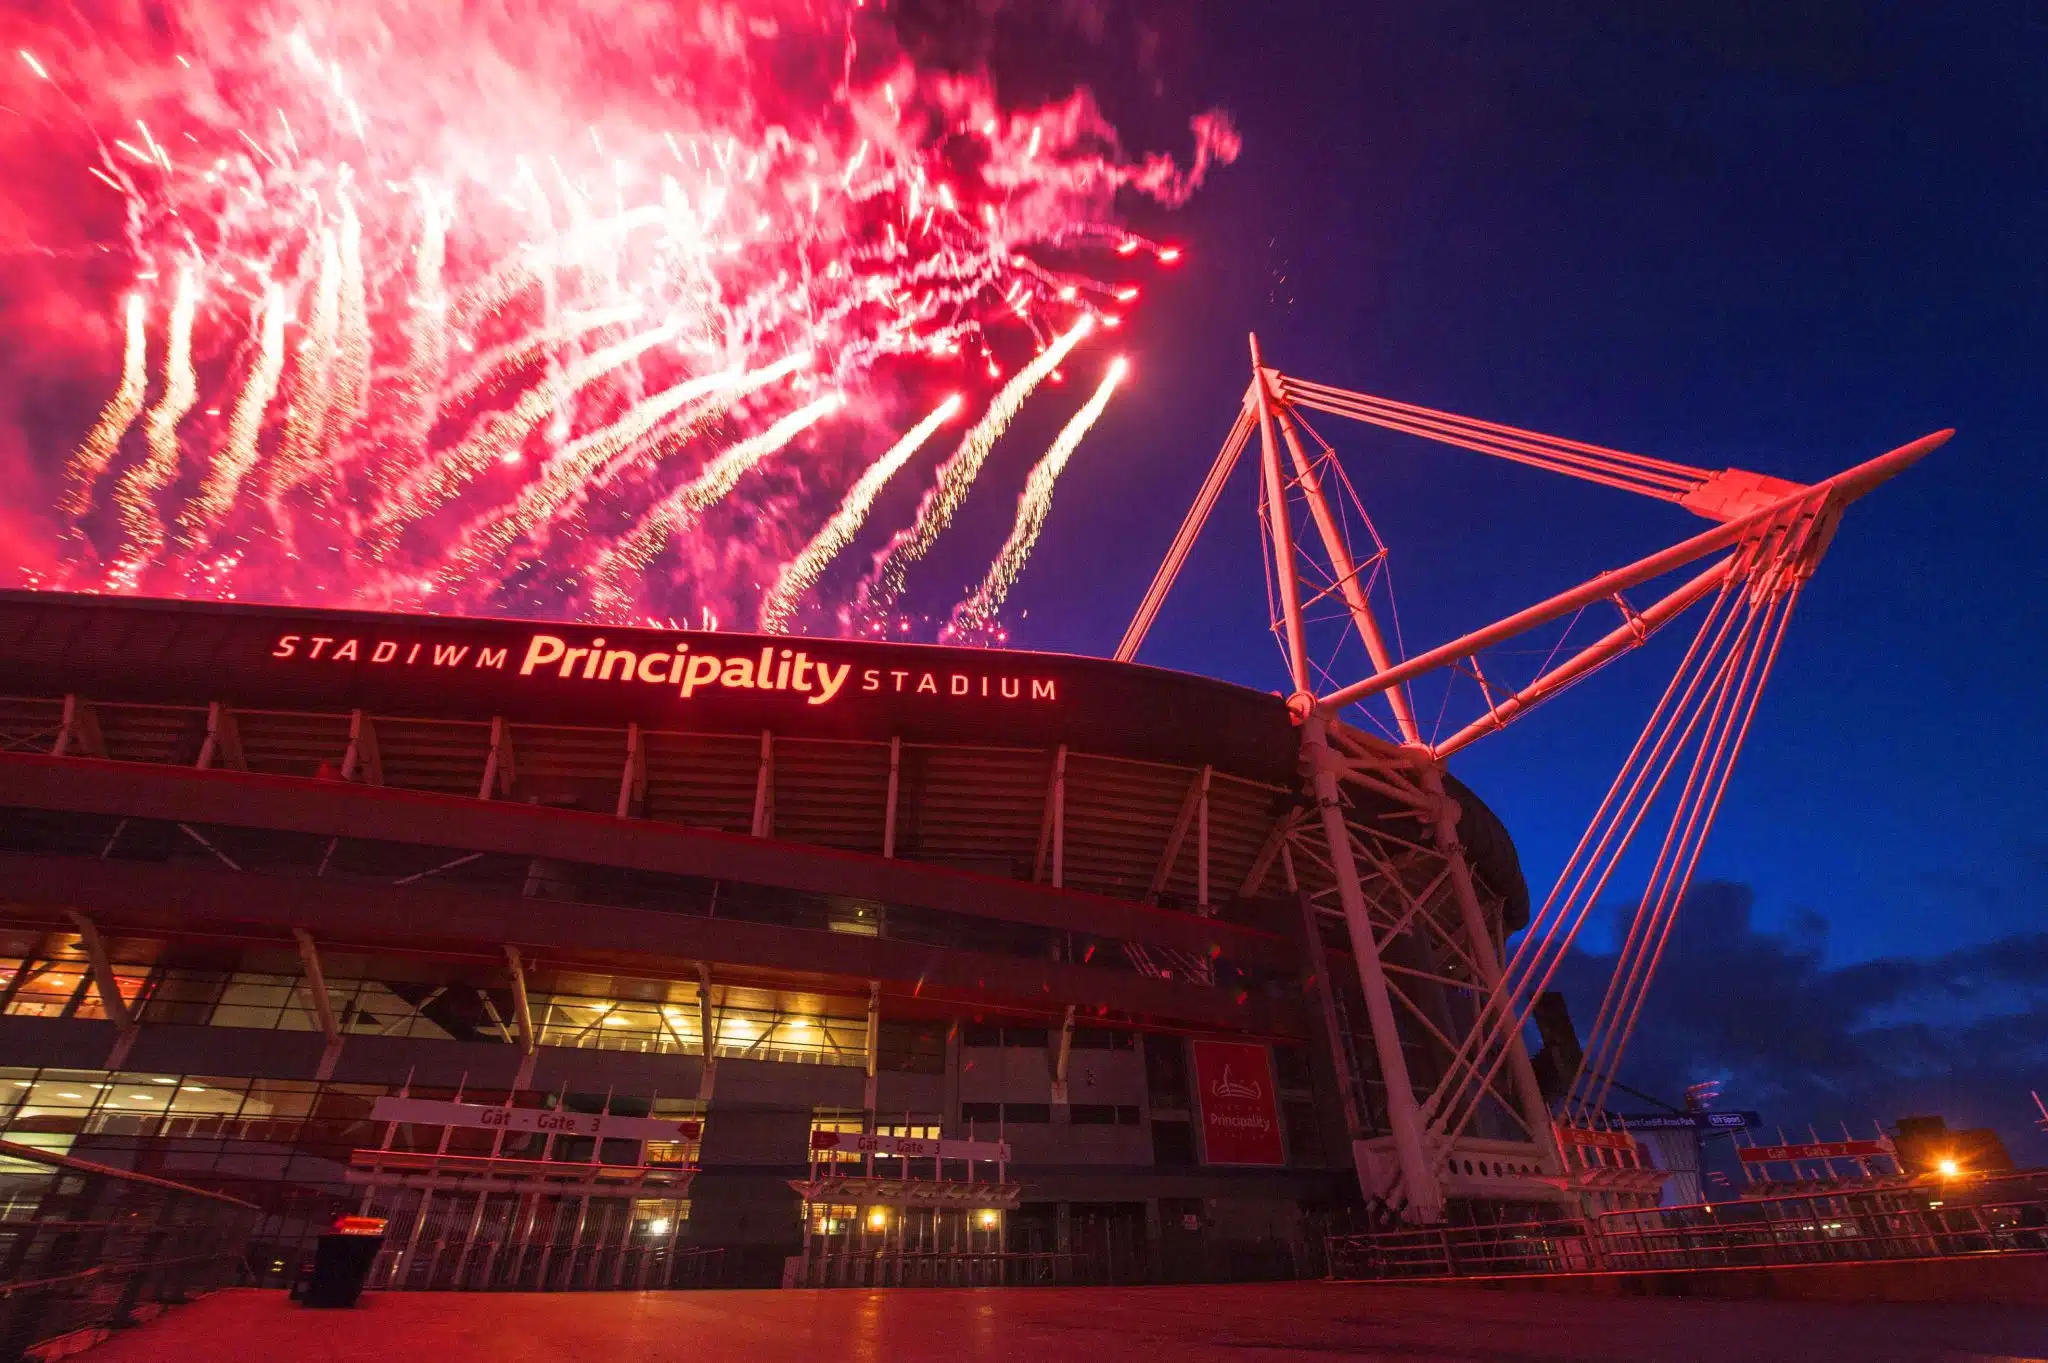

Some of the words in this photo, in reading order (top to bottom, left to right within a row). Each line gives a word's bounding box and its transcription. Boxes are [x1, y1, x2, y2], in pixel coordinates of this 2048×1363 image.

[272, 635, 508, 670] STADIWM
[519, 634, 851, 706] Principality
[862, 669, 1058, 702] STADIUM
[537, 1113, 576, 1131] Gate
[591, 1118, 601, 1132] 3
[1210, 1112, 1270, 1132] Principality
[1723, 1116, 1741, 1125] Sport
